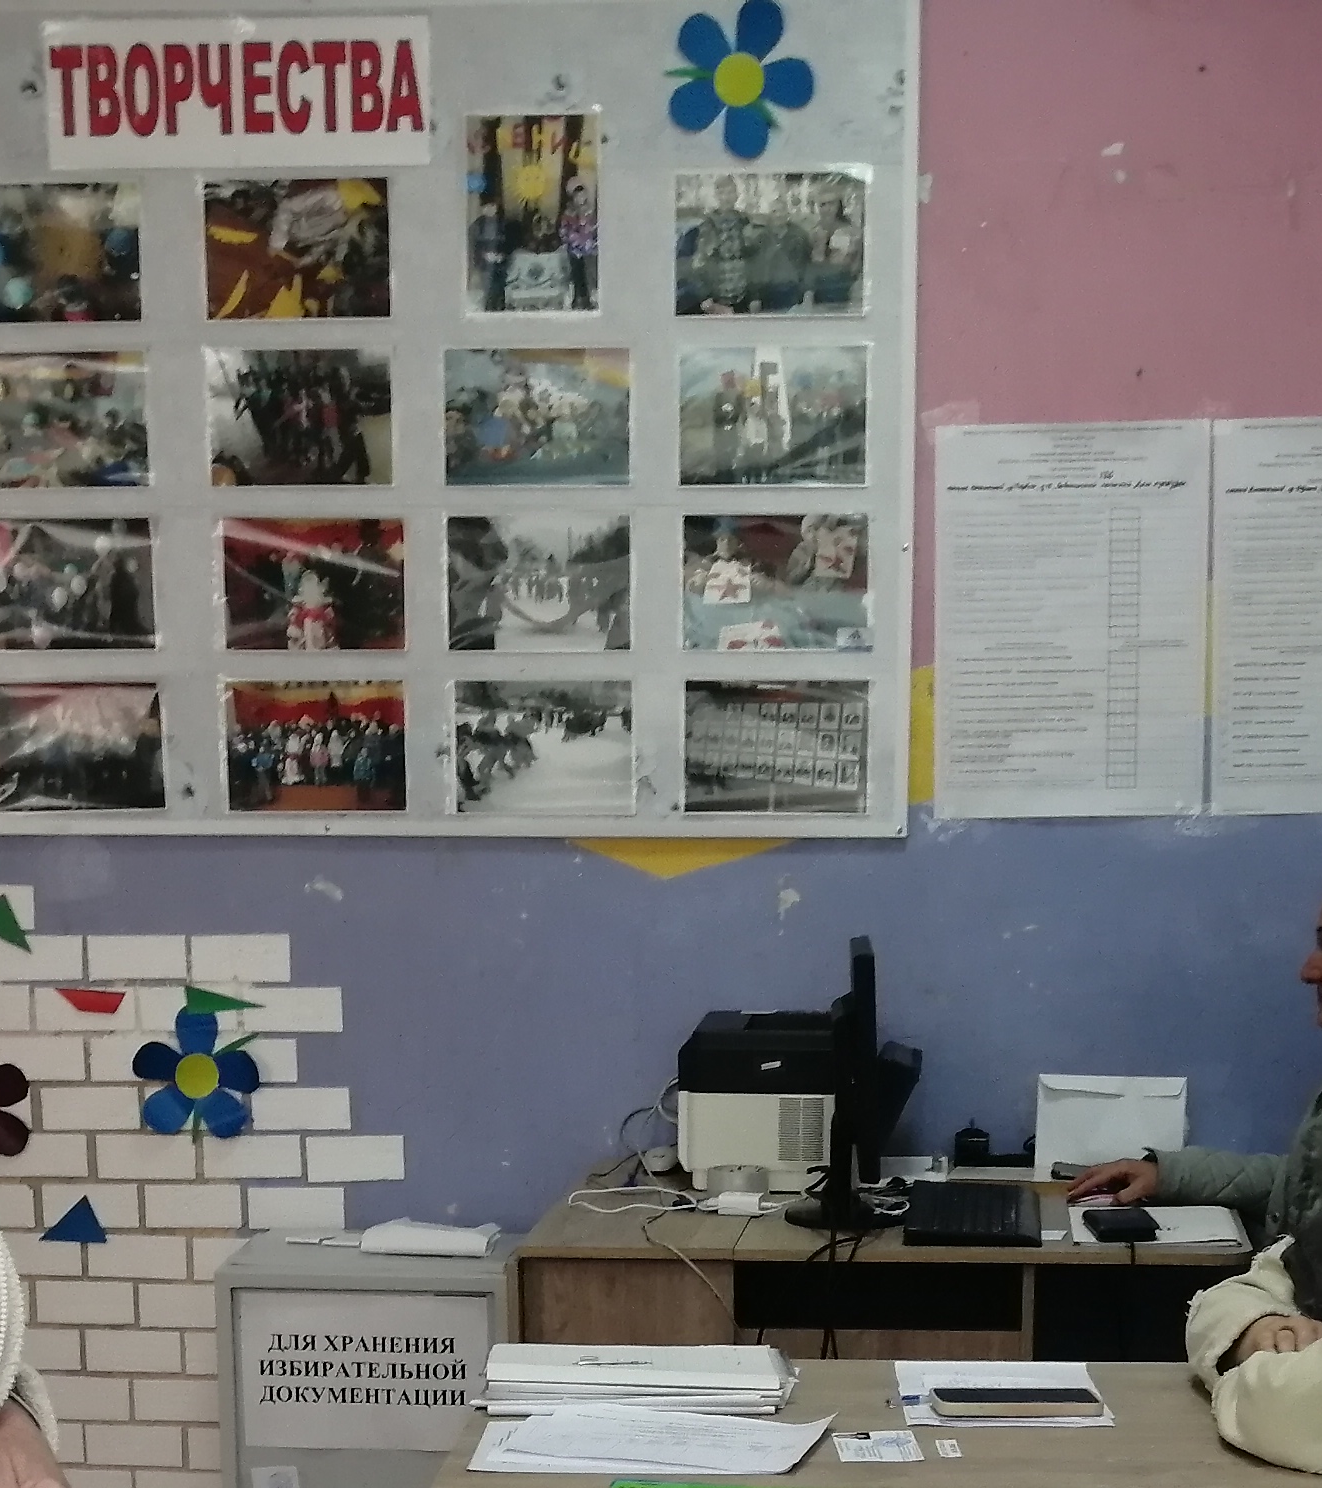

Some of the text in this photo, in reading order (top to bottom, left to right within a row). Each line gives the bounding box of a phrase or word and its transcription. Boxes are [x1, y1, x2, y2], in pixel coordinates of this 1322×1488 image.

[49, 40, 425, 137] ТВОРЧЕСТВА
[268, 1334, 456, 1354] ДЛЯ ХРАНЕНИЯ
[259, 1359, 467, 1380] ИЗБИРАТЕЛЬНОЙ
[260, 1386, 466, 1408] ДОКУМЕНТАЦИИ
